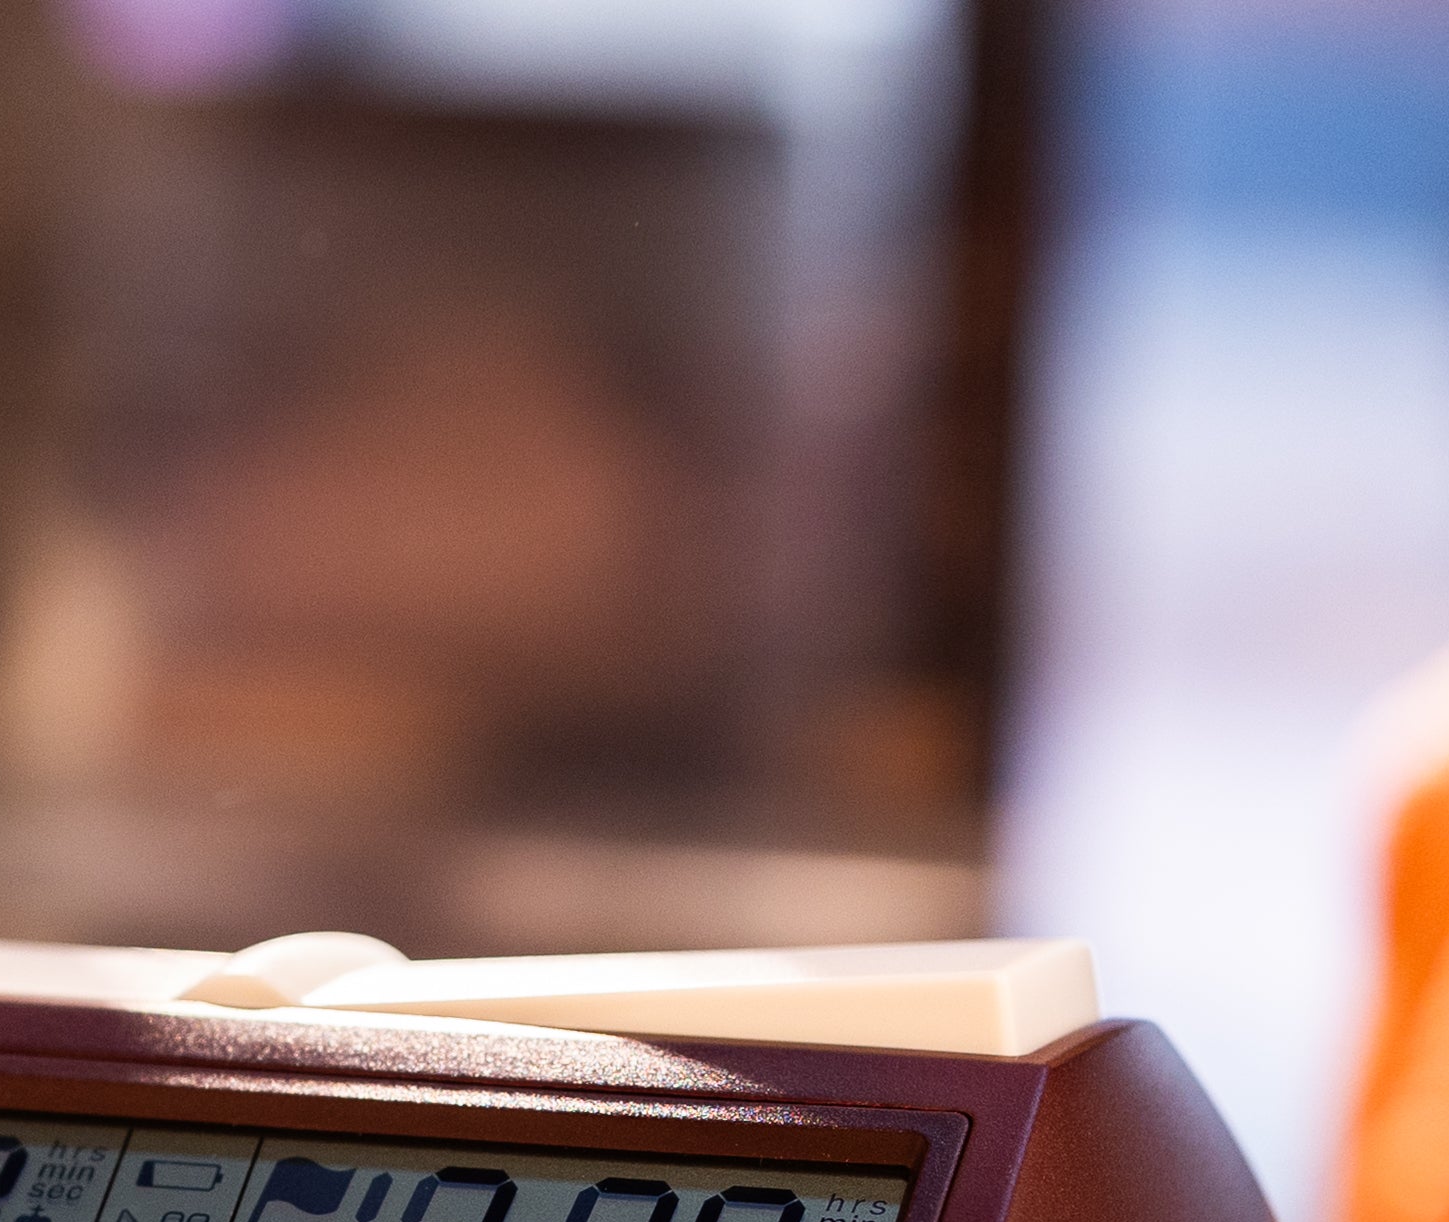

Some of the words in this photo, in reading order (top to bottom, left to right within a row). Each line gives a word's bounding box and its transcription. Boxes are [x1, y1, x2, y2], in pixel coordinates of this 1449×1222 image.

[47, 1140, 106, 1161] hrs
[38, 1162, 95, 1182] min
[28, 1182, 84, 1200] sec
[826, 1193, 888, 1215] hrs
